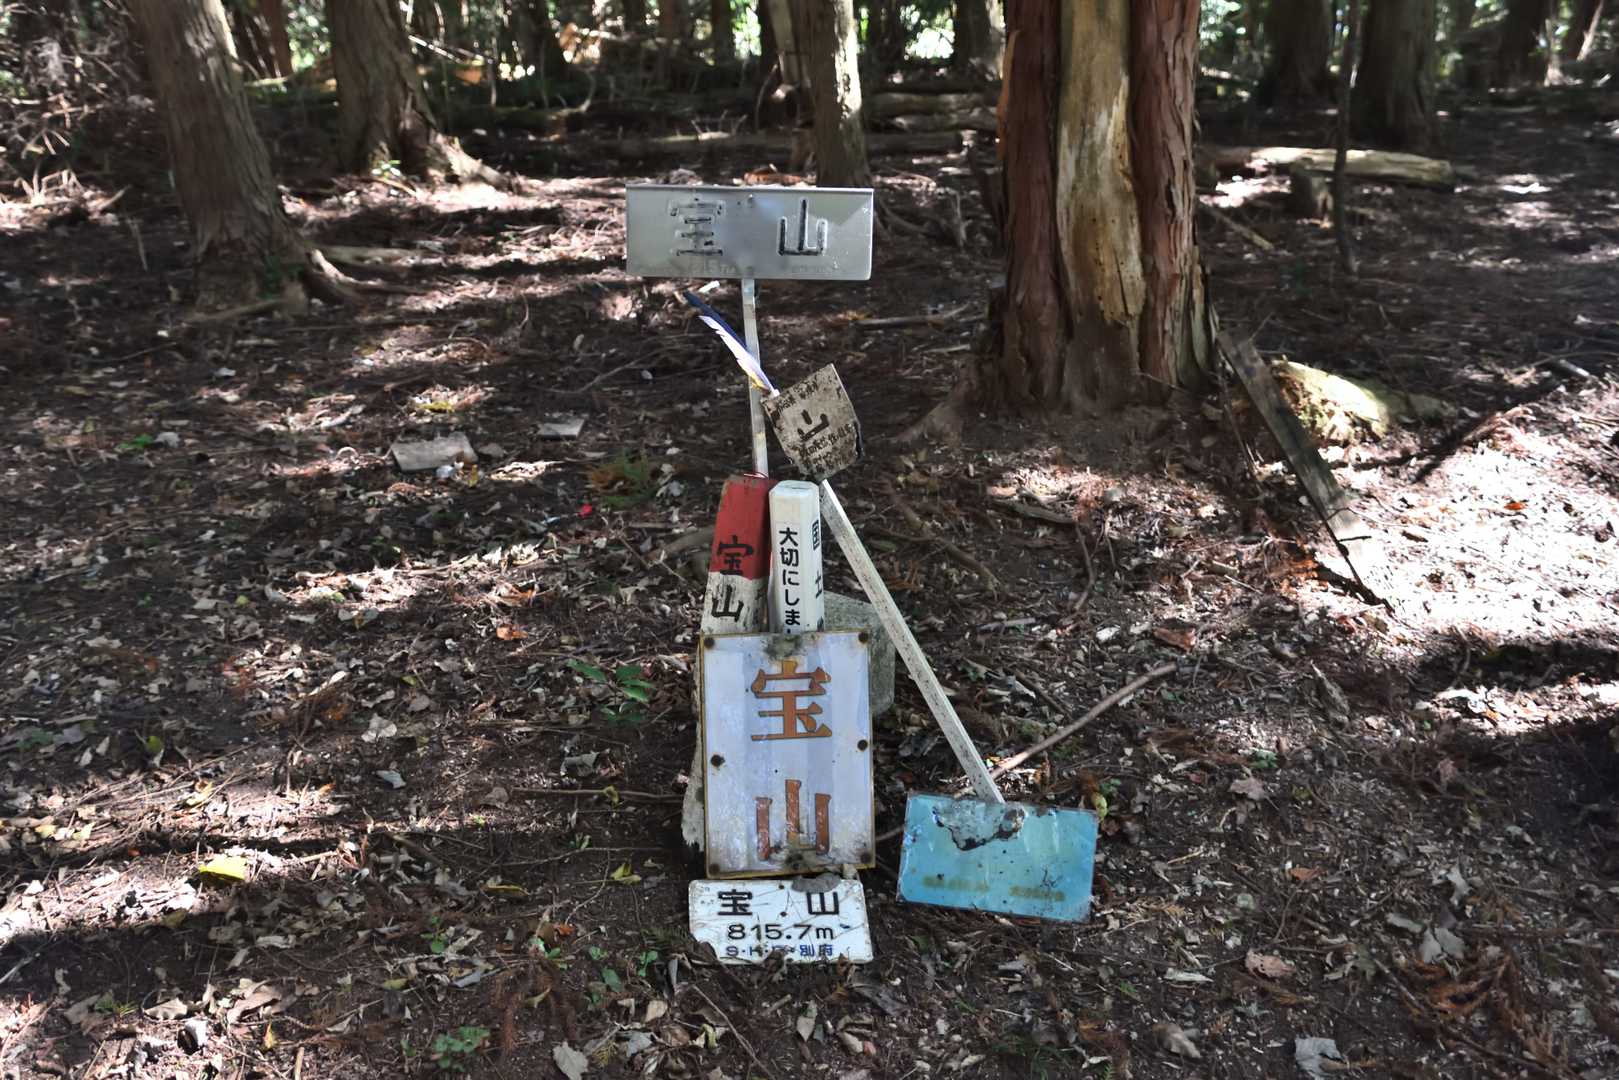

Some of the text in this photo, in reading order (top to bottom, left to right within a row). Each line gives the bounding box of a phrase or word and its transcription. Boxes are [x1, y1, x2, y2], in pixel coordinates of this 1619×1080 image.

[668, 197, 829, 256] 宝山
[710, 535, 754, 622] 宝山
[779, 527, 801, 633] 大切にしま
[750, 660, 832, 861] 宝山
[717, 889, 840, 916] 宝山
[727, 923, 834, 940] 815.7m
